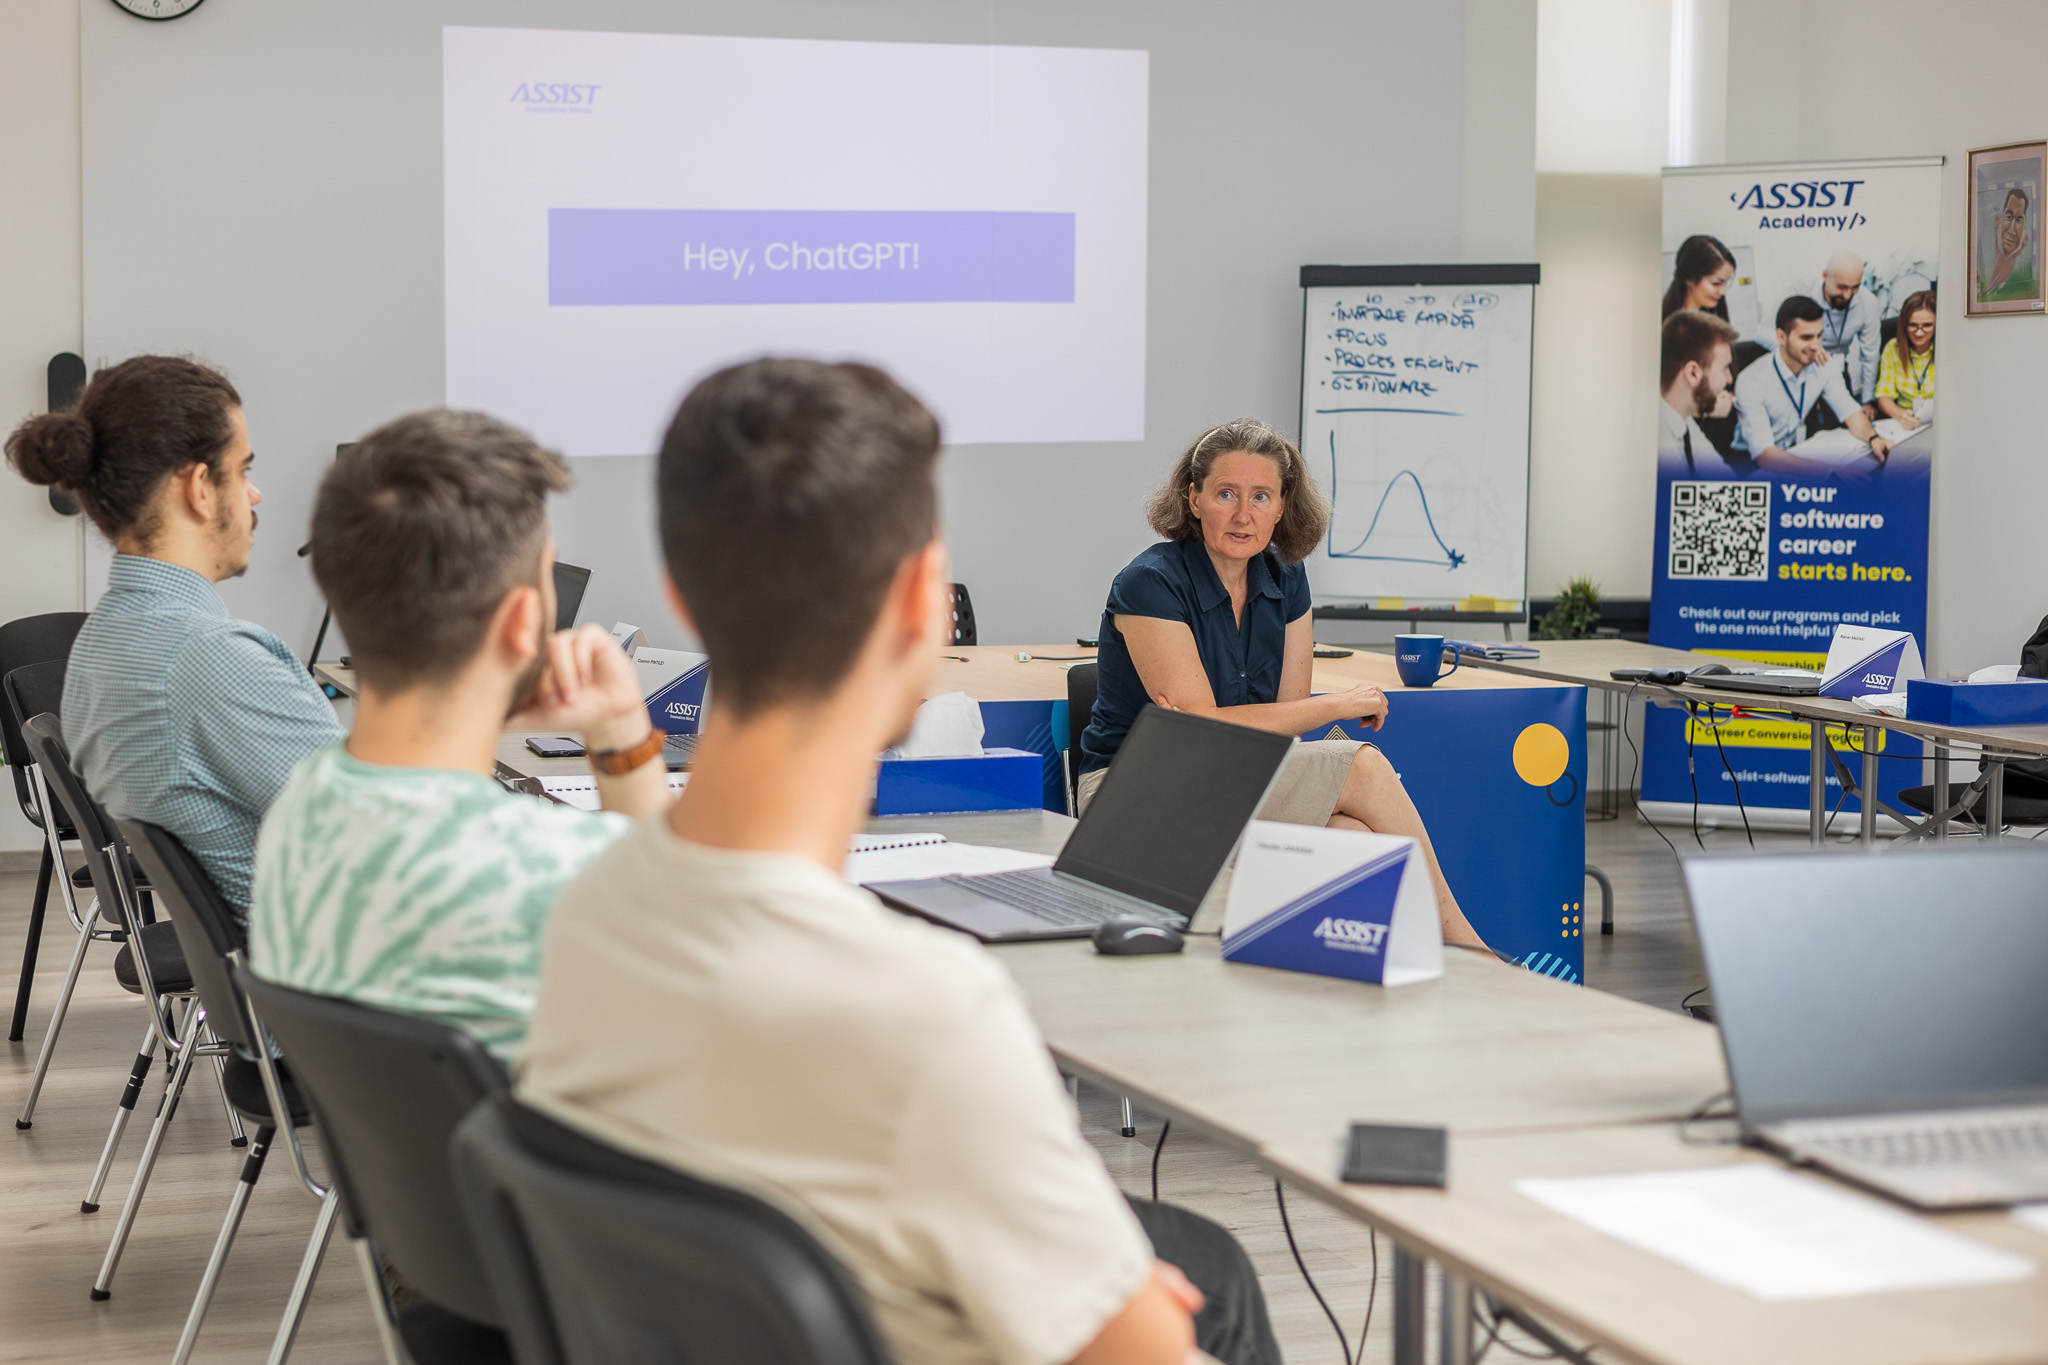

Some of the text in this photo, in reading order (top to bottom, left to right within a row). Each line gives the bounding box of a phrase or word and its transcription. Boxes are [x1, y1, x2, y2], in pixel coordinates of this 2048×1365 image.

[509, 82, 603, 104] ASSIST
[683, 241, 921, 280] Hey, ChatGPT!
[1334, 328, 1388, 346] FOCUS
[1334, 349, 1396, 369] PROCES
[1781, 484, 1837, 503] Your
[1779, 508, 1884, 529] software
[1779, 538, 1857, 555] career
[1777, 562, 1912, 581] starts here.
[1679, 606, 1900, 627] Check out our programs and pick
[1694, 621, 1717, 634] the
[1719, 624, 1744, 635] one
[1746, 624, 1779, 635] most
[1780, 624, 1830, 639] helpful
[1861, 673, 1895, 686] ASSIST
[664, 701, 700, 717] ASSIST
[1748, 729, 1811, 740] Conversio
[1312, 916, 1389, 947] ASSIST
